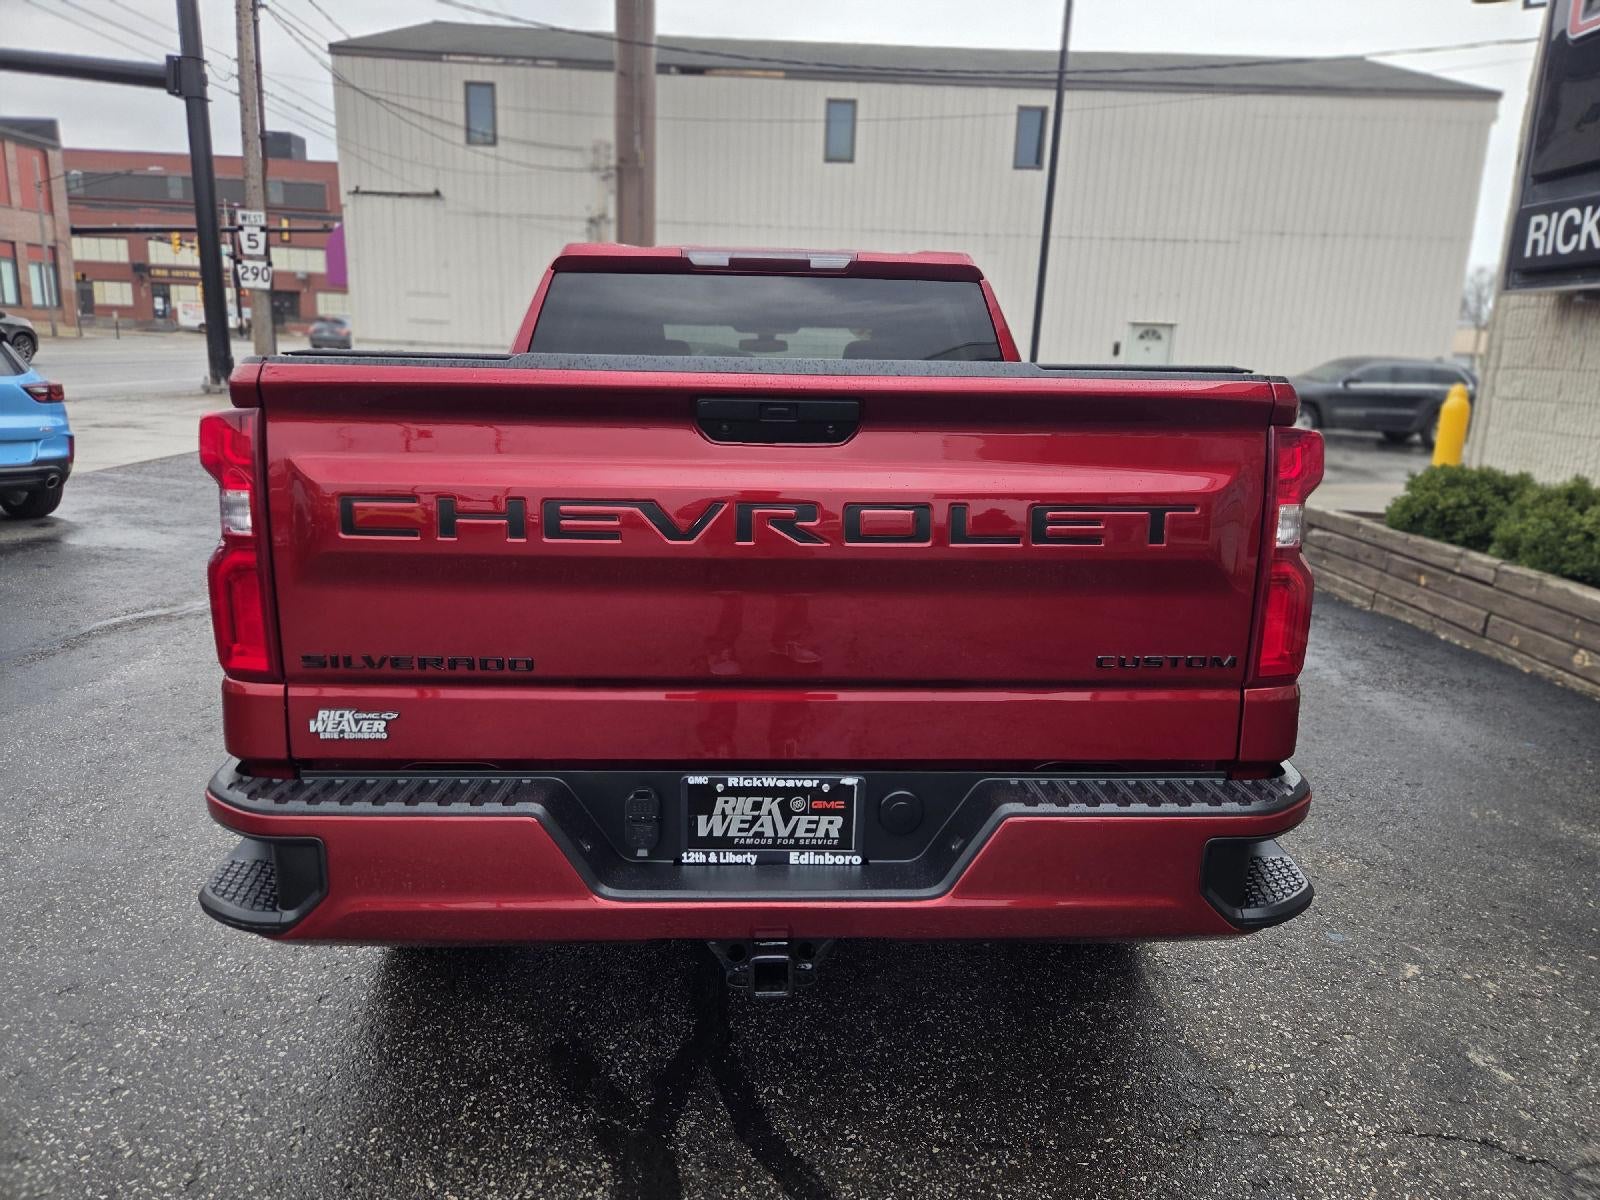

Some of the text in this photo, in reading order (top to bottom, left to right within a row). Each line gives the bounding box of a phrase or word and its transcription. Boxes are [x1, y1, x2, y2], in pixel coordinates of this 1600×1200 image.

[241, 214, 263, 222] WEST
[1524, 206, 1600, 257] RICK
[247, 233, 259, 249] 5
[241, 265, 270, 282] 290
[339, 494, 1200, 547] CHEVROLET
[301, 654, 535, 672] SILVERADO
[1096, 655, 1237, 668] CUSTOM
[318, 710, 356, 720] RICK
[309, 720, 386, 733] WEAVER
[687, 776, 709, 785] GMC
[712, 797, 784, 816] RICK
[811, 800, 845, 809] GMC
[697, 815, 844, 838] WEAVER
[681, 851, 758, 865] 12th & Liberty
[789, 851, 862, 865] Edinboro
